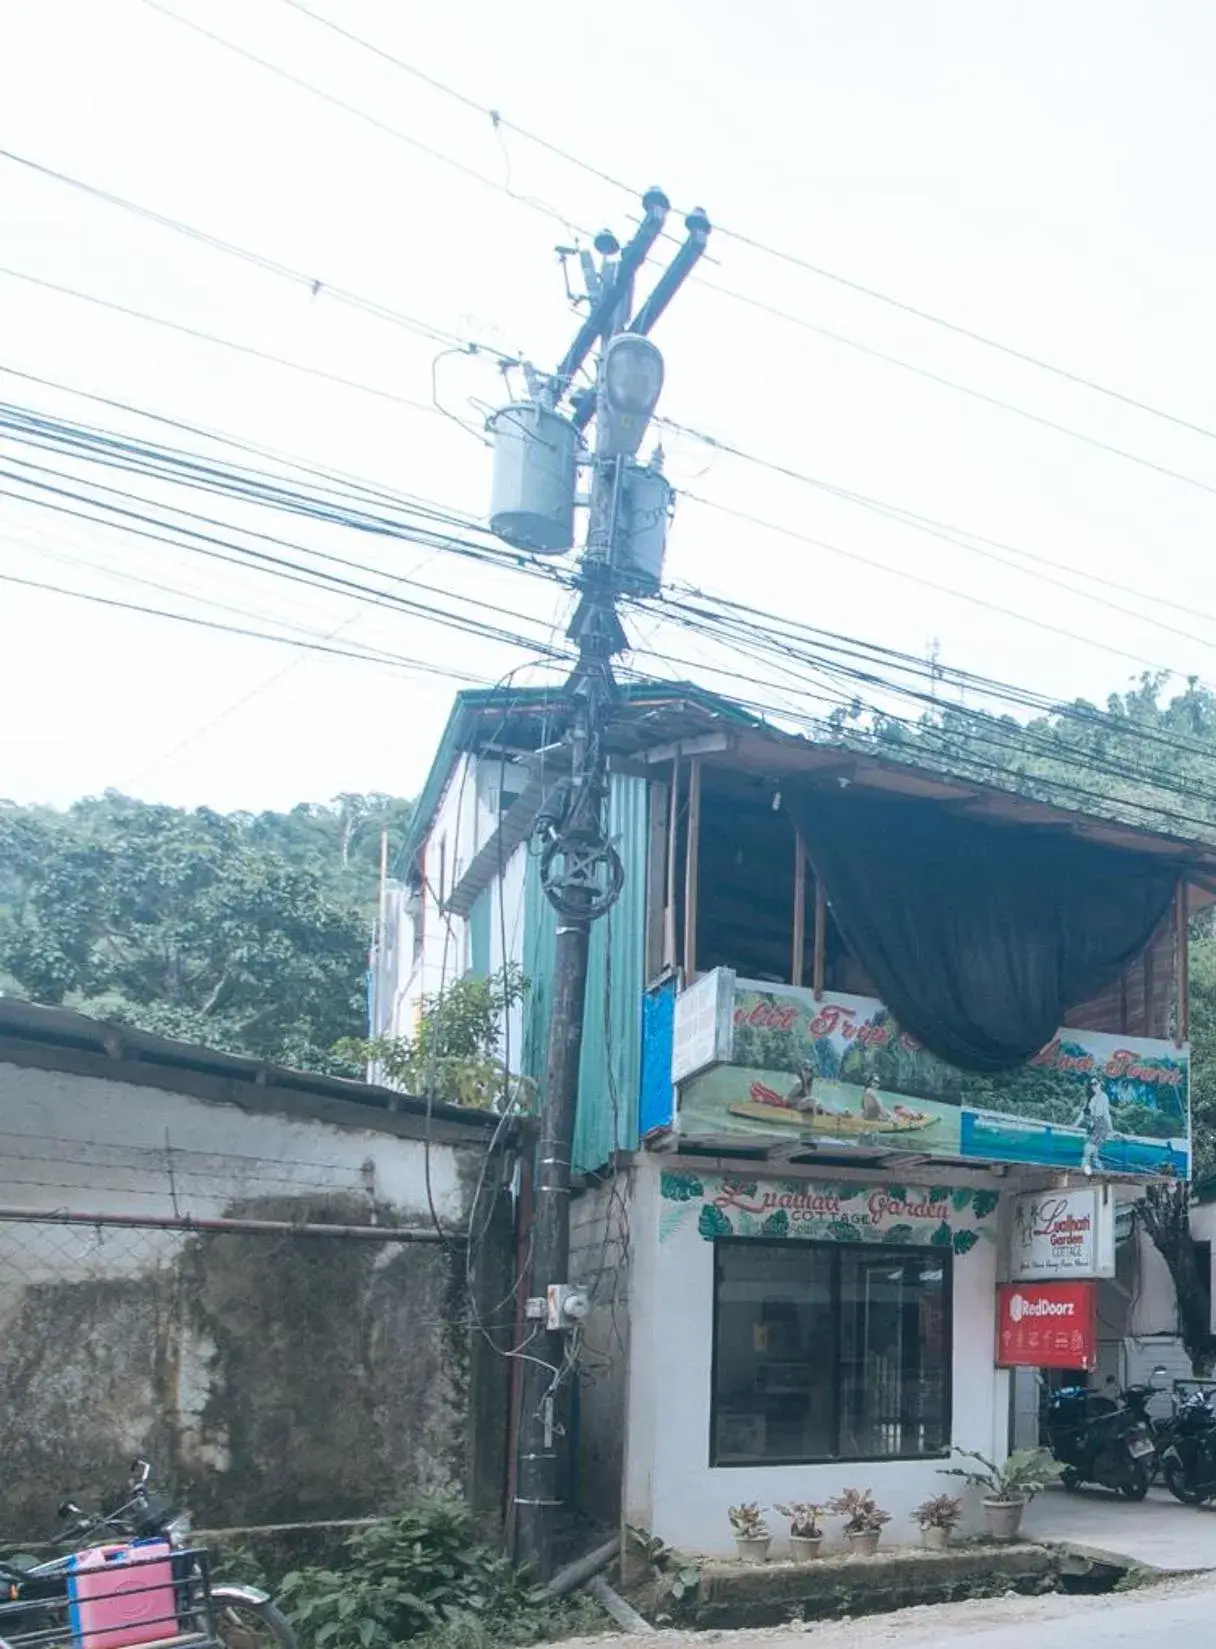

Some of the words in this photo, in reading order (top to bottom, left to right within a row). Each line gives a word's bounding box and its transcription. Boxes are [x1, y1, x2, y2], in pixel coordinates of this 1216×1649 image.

[809, 1003, 889, 1046] Trip
[867, 1184, 951, 1224] Garden
[1050, 1234, 1084, 1246] Garden
[1022, 1298, 1076, 1317] RedDoorz
